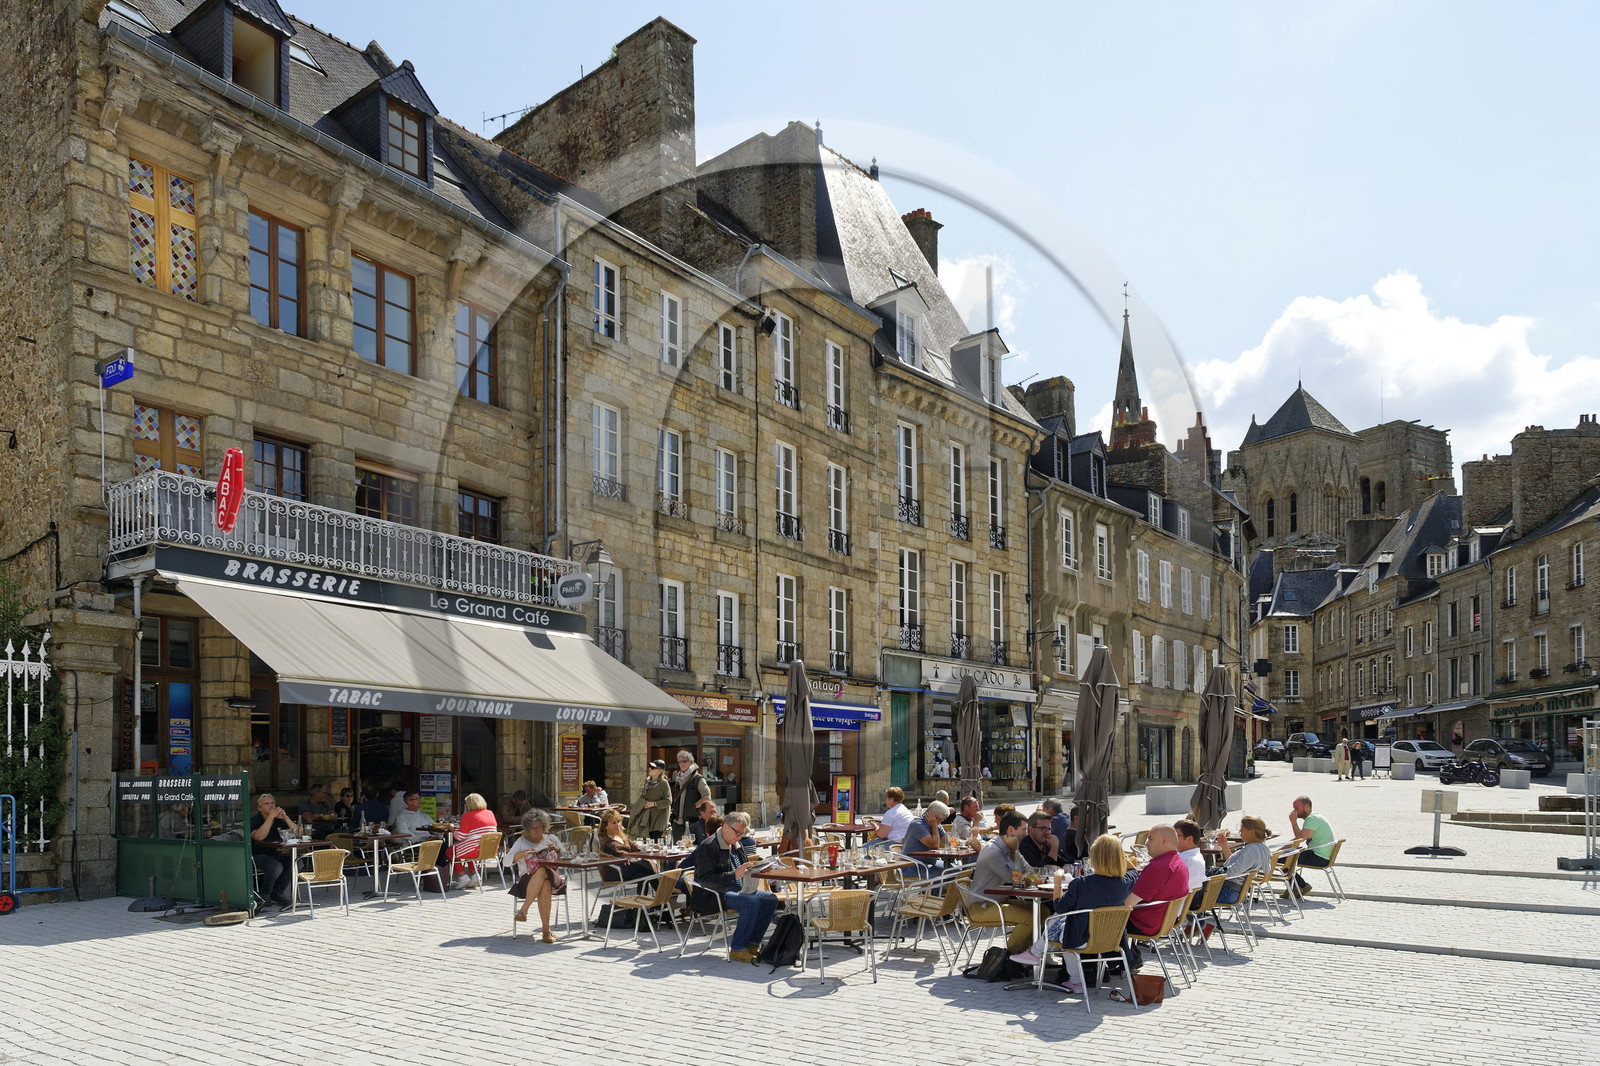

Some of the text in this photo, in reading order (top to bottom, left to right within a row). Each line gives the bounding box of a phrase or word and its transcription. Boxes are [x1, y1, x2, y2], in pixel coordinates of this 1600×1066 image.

[217, 453, 233, 526] TABAC
[223, 559, 361, 596] BRASSERIE
[562, 586, 575, 594] PMU
[430, 593, 550, 626] Le Grand Café
[973, 669, 1005, 686] CADO
[327, 687, 384, 706] TABAC
[1545, 692, 1595, 711] martin
[435, 697, 513, 717] JOURNAUX
[556, 706, 613, 724] LOTO/FDJ
[646, 713, 670, 727] PMU
[158, 778, 192, 788] BRASSERIE
[217, 779, 242, 787] JOURNAUX
[157, 792, 194, 801] Le Grand Café
